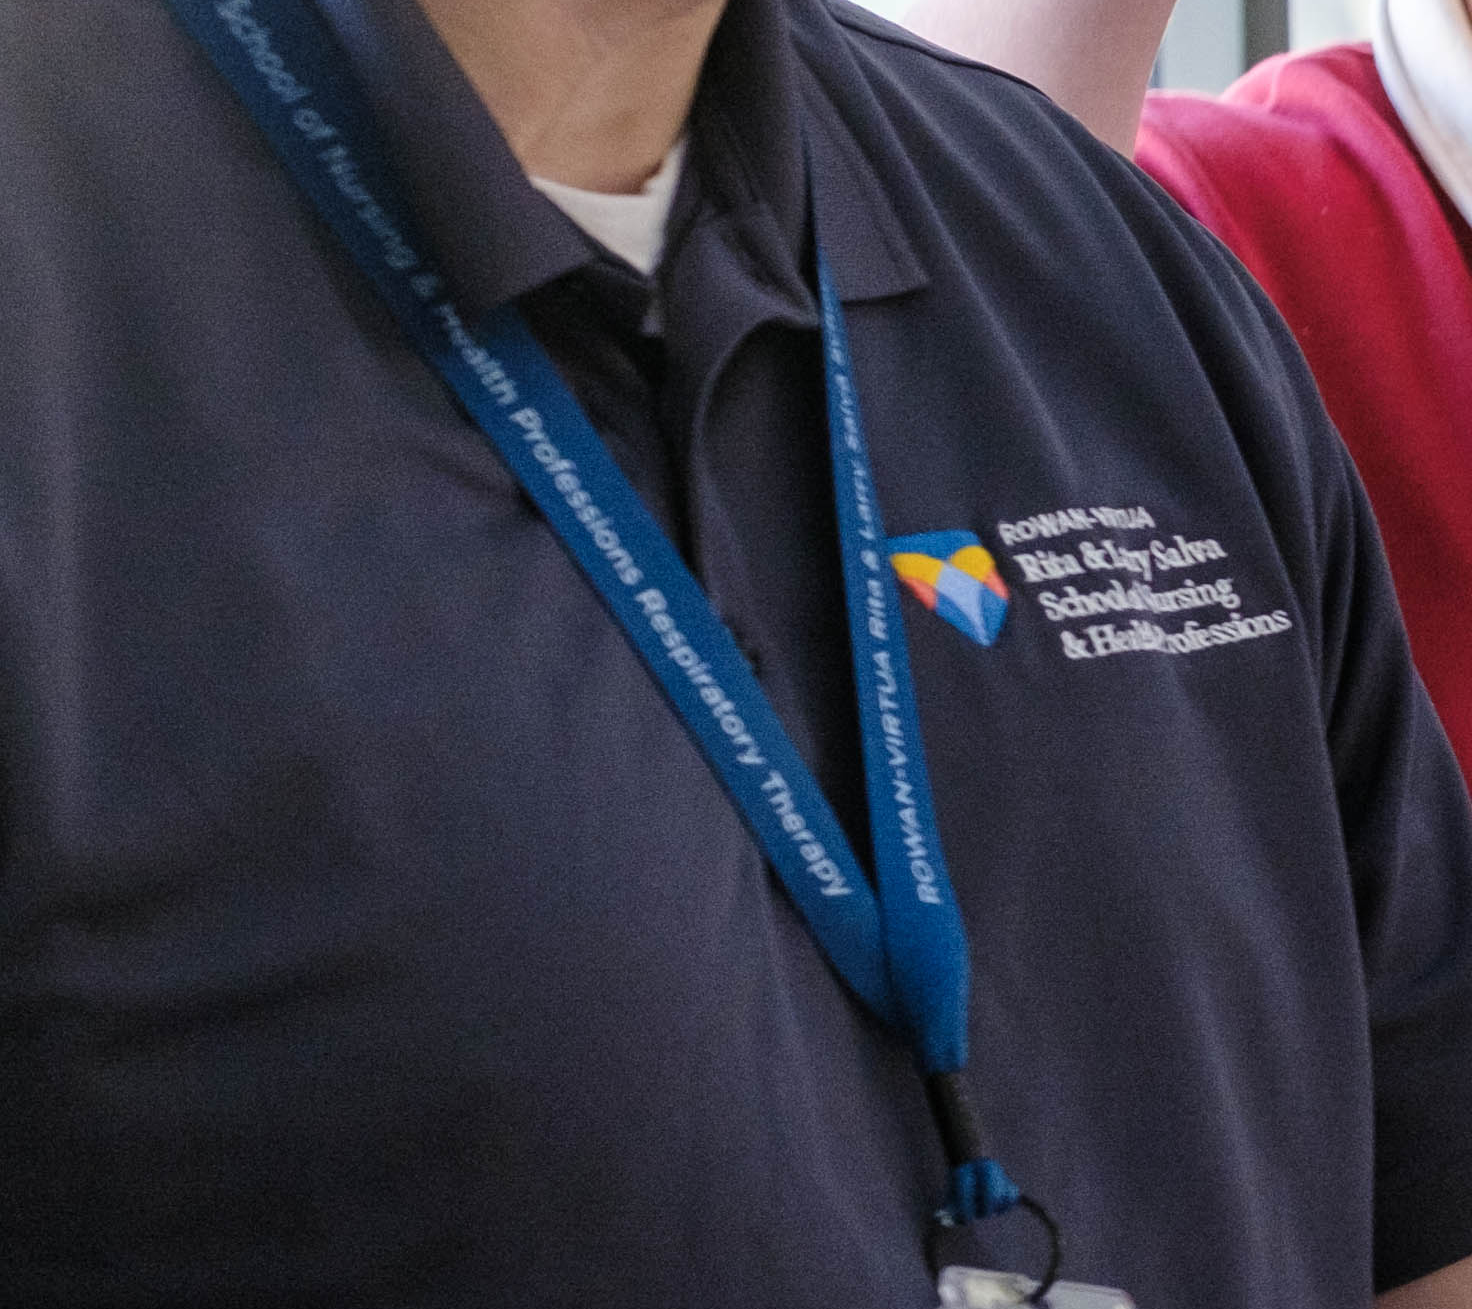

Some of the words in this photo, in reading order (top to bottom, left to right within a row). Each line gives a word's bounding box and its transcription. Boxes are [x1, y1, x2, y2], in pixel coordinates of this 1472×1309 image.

[293, 107, 338, 141] of
[319, 145, 418, 269] Nursing
[510, 407, 644, 586] Professions
[634, 588, 766, 766] Respiratory
[761, 770, 852, 897] Therapy
[1013, 550, 1086, 583] Rita
[1150, 535, 1228, 570] Salva
[1038, 579, 1127, 621] School
[1060, 630, 1096, 659] &
